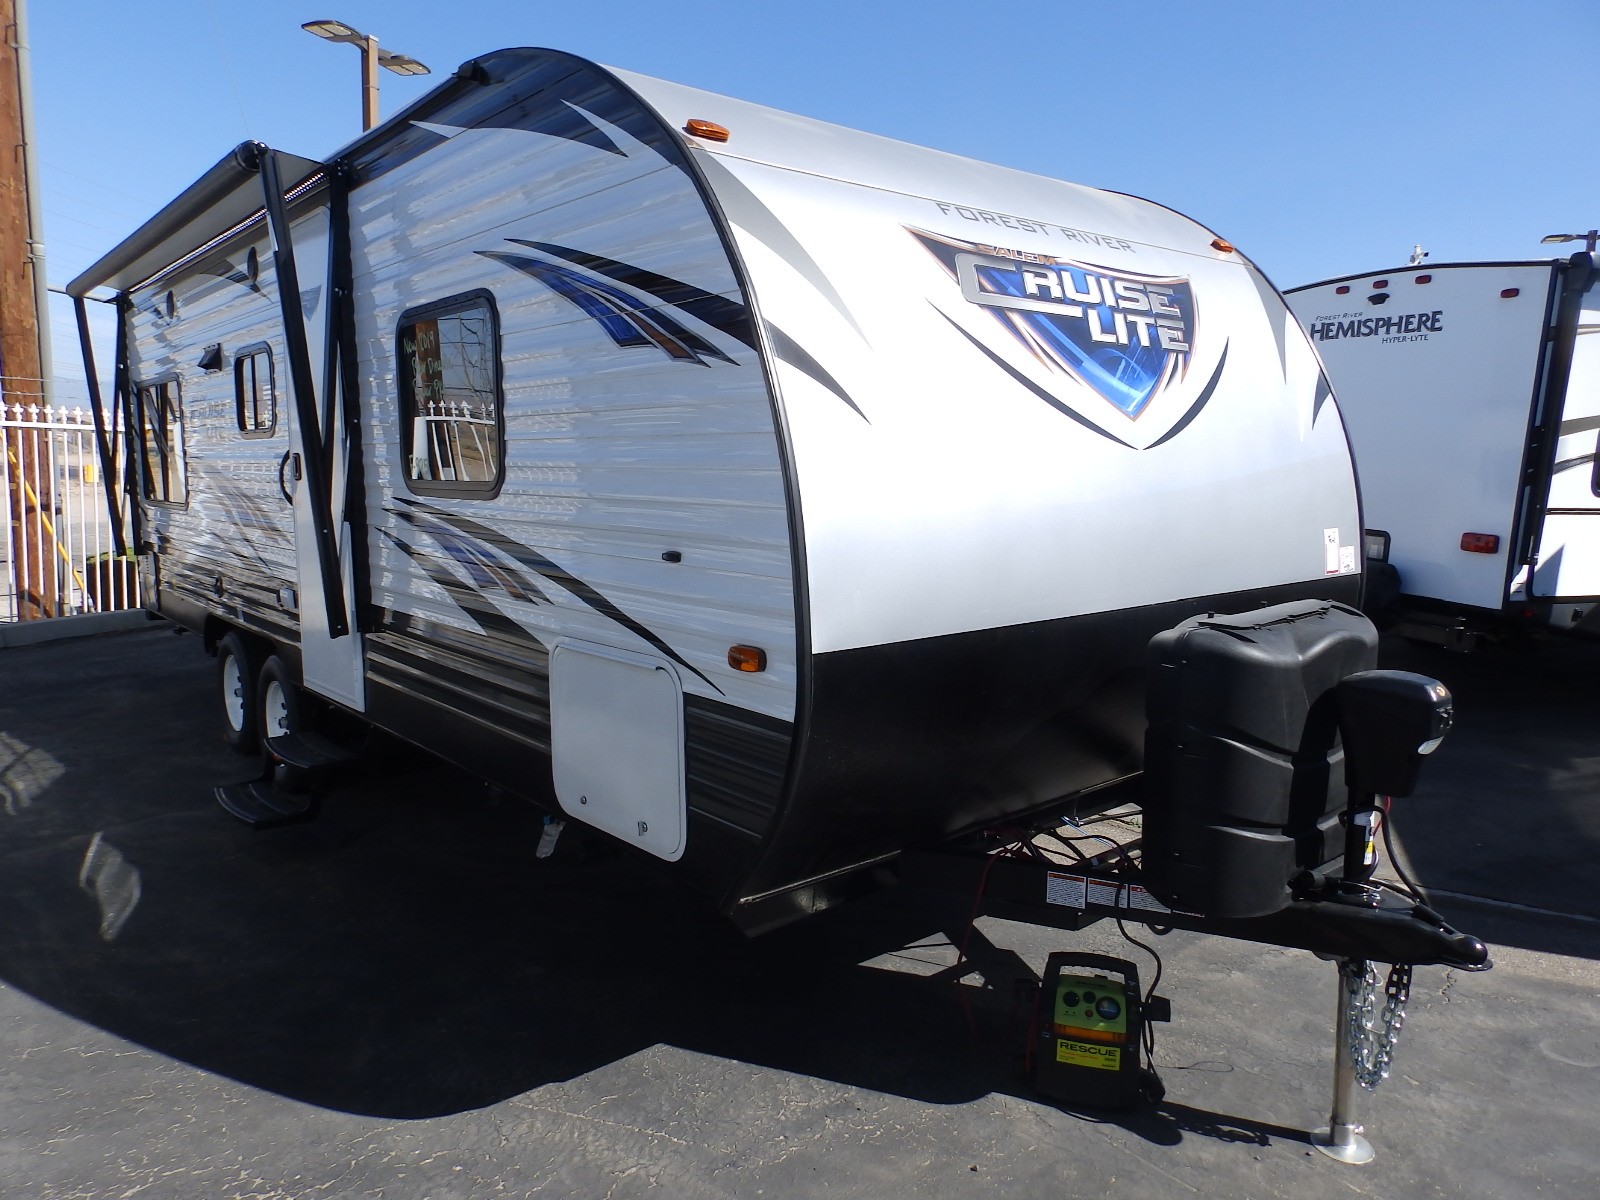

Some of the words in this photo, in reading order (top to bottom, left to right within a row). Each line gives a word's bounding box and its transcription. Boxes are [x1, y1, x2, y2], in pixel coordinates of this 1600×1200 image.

[936, 202, 1049, 236] FOREST
[1060, 228, 1136, 254] RIVER
[975, 243, 1057, 267] SALEM
[955, 253, 1182, 319] CRUISE
[1087, 308, 1189, 353] LITE
[1310, 310, 1443, 341] HEMISPHERE
[1381, 333, 1429, 344] HYPER-LYTE
[1060, 1041, 1117, 1057] RESCUE
